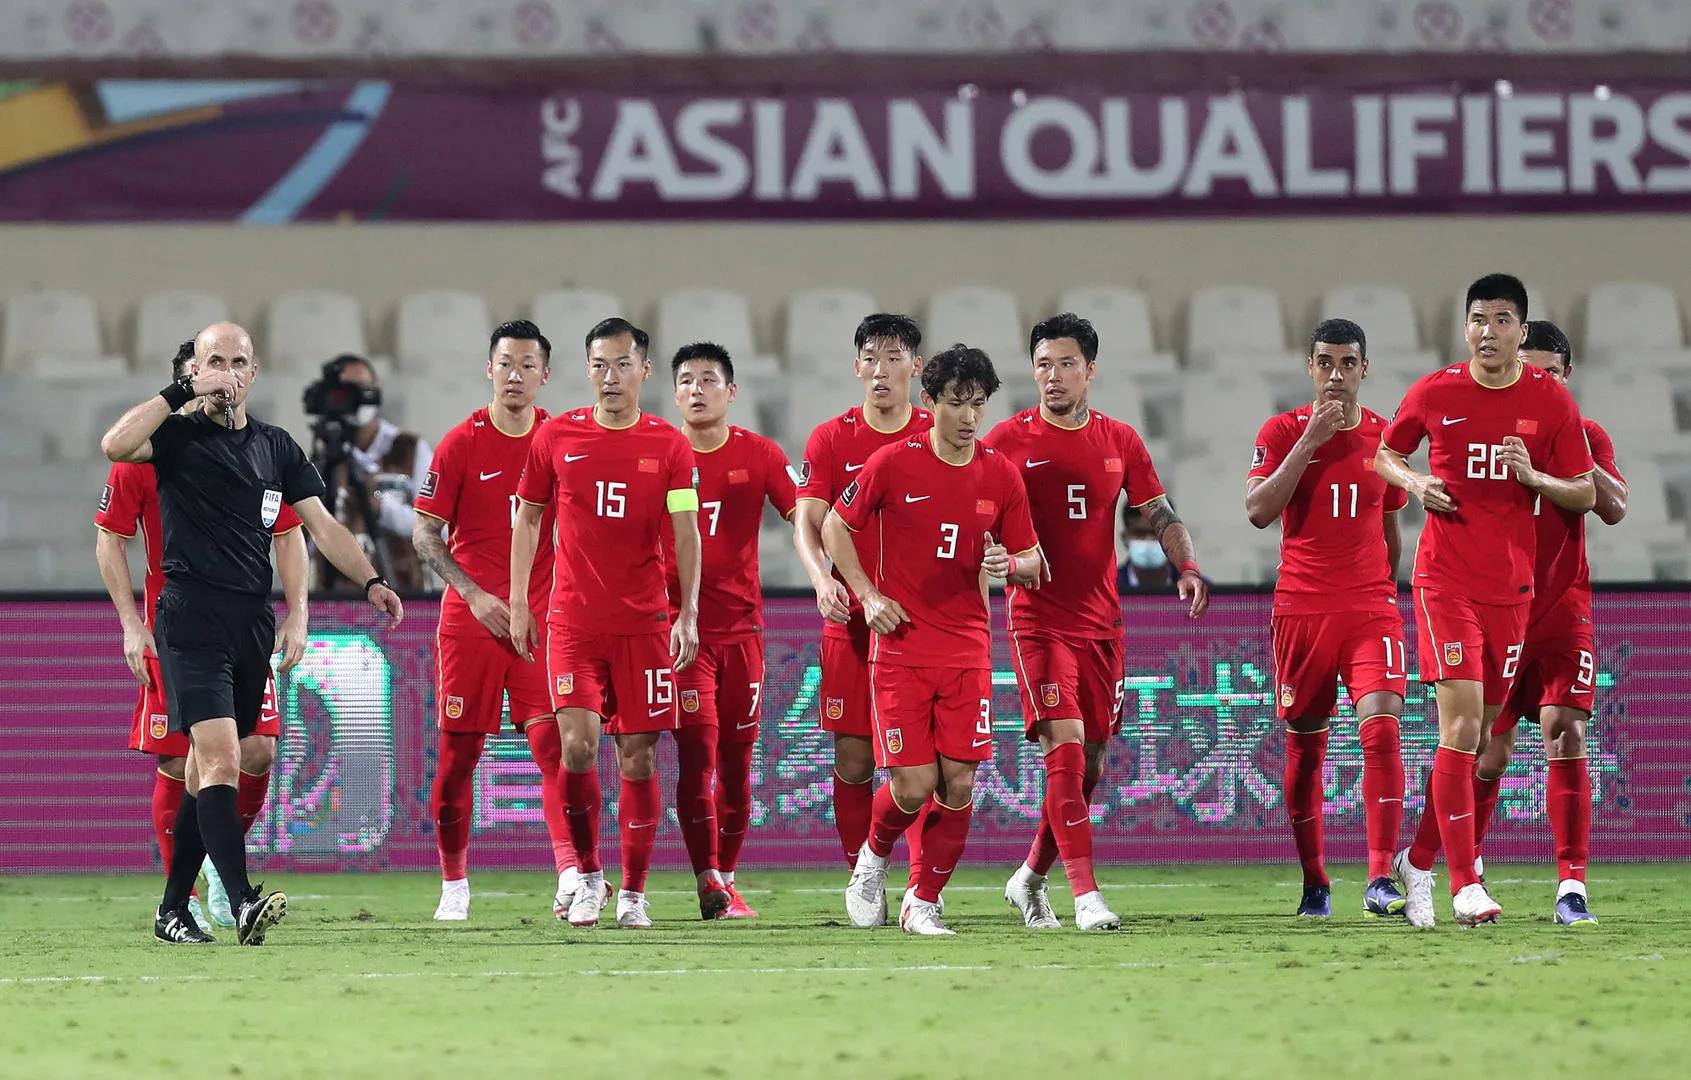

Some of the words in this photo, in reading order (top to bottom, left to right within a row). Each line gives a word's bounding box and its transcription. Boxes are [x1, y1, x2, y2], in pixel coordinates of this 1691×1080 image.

[541, 99, 582, 198] AFC
[590, 99, 976, 200] ASIAN
[1001, 94, 1691, 200] QUALIFIERS
[264, 492, 279, 503] FIFA
[596, 481, 626, 518] 15
[1067, 484, 1087, 520] 5
[1330, 483, 1359, 519] 11
[702, 501, 721, 536] 7
[936, 523, 960, 559] 3
[1382, 636, 1405, 673] 11
[1502, 640, 1524, 678] 2
[1577, 650, 1594, 687] 9
[645, 668, 672, 704] 15
[749, 682, 760, 717] 7
[1113, 679, 1125, 714] 5
[976, 698, 991, 734] 3
